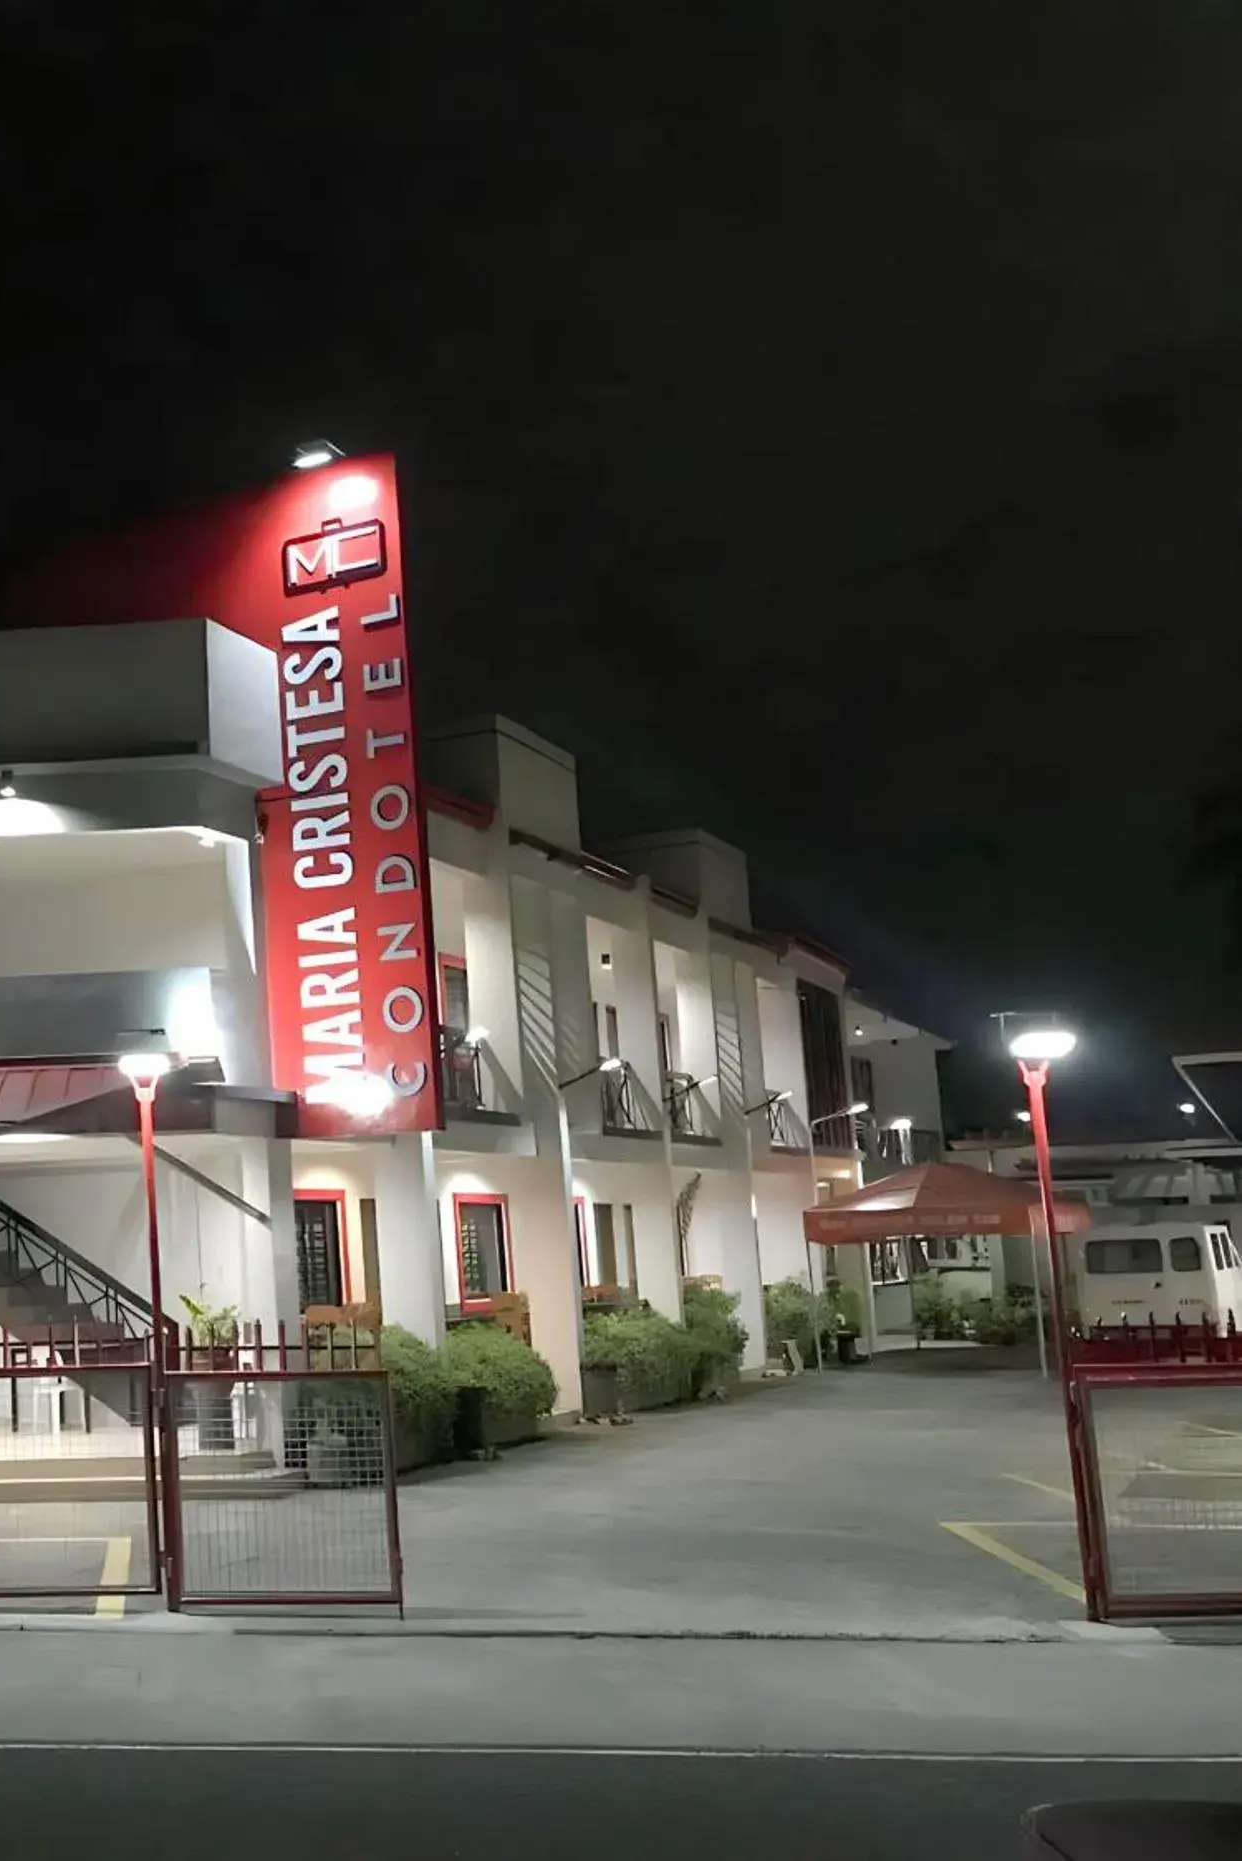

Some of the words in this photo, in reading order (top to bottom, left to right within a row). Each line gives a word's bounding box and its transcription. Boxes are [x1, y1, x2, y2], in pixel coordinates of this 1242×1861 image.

[281, 606, 354, 889] CRISTESA
[360, 593, 426, 1097] CONDOTEL
[297, 907, 364, 1104] MARIA
